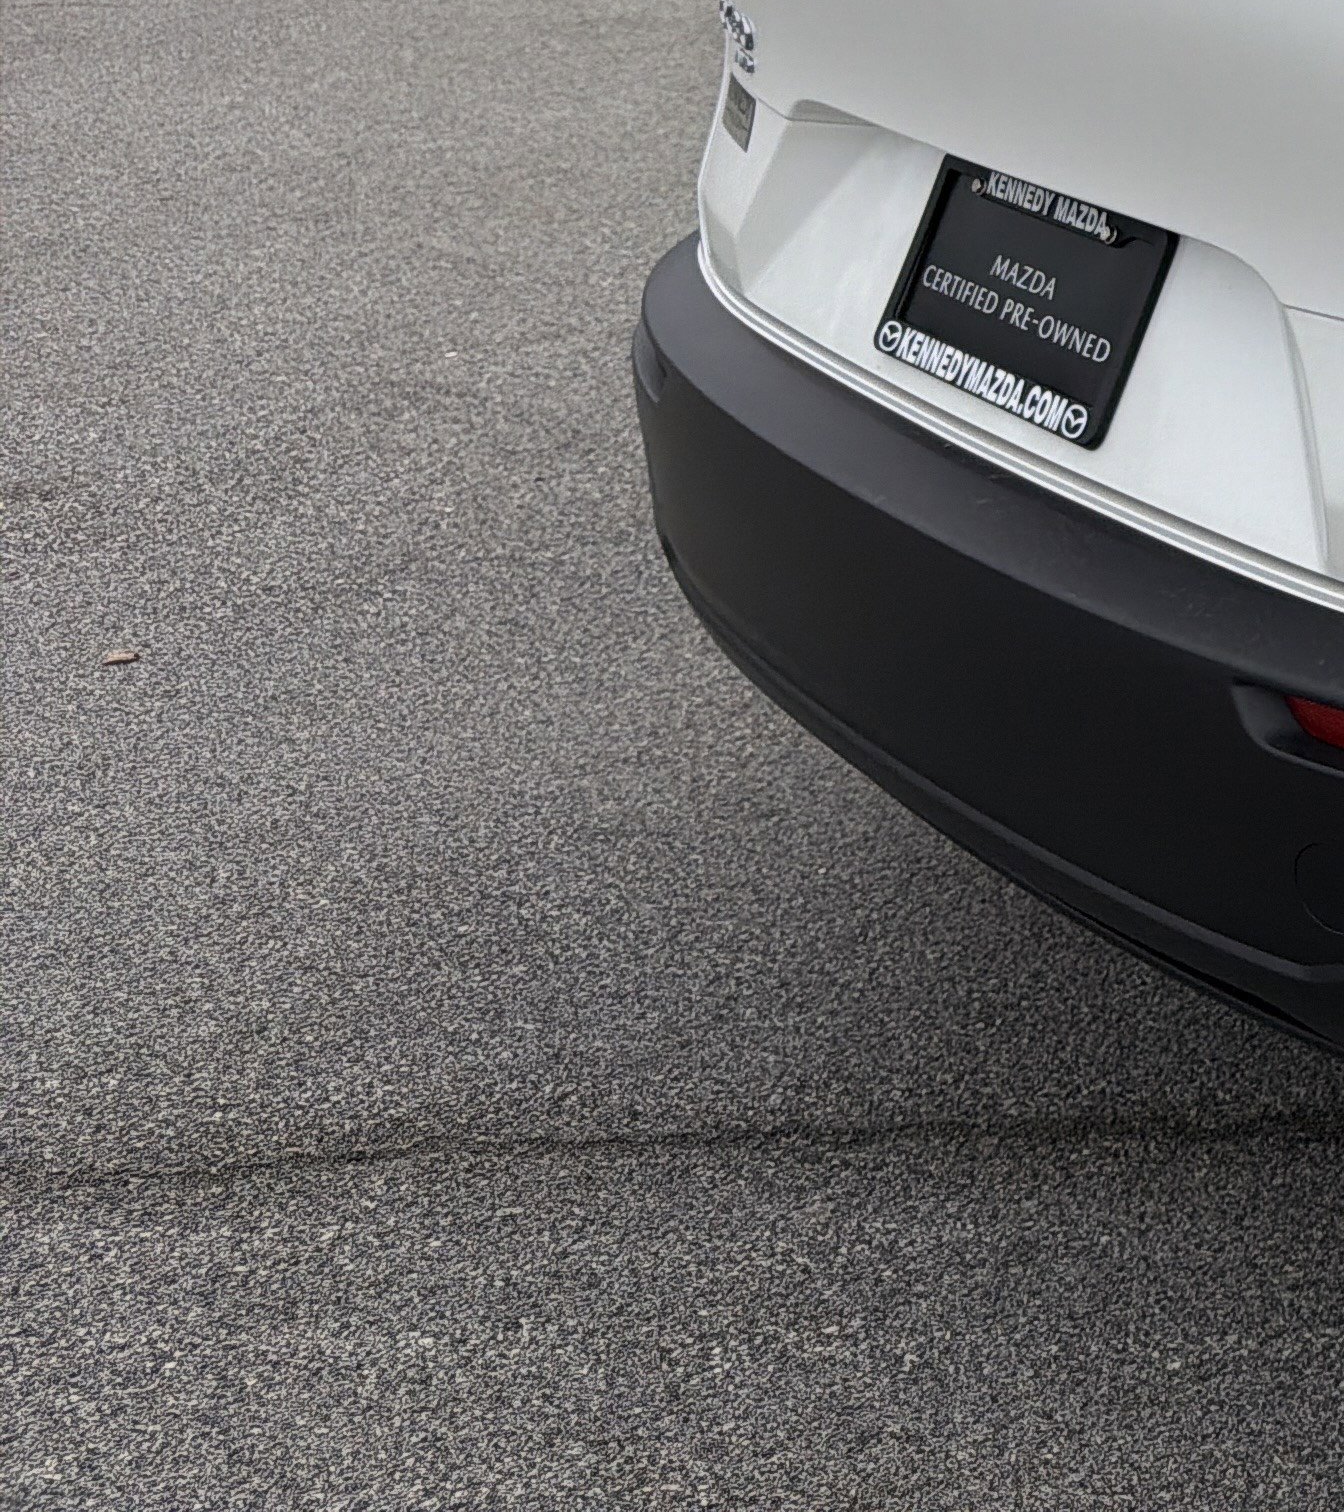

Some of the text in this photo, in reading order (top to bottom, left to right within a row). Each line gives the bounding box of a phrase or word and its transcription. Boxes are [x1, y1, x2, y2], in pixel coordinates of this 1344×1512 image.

[986, 170, 1111, 240] KENNEDY MAZDA
[922, 263, 1112, 364] CERTIFIED PRE-OWNED
[989, 254, 1056, 301] MAZDA
[895, 326, 1069, 432] KENNEDYMAZDA.COM
